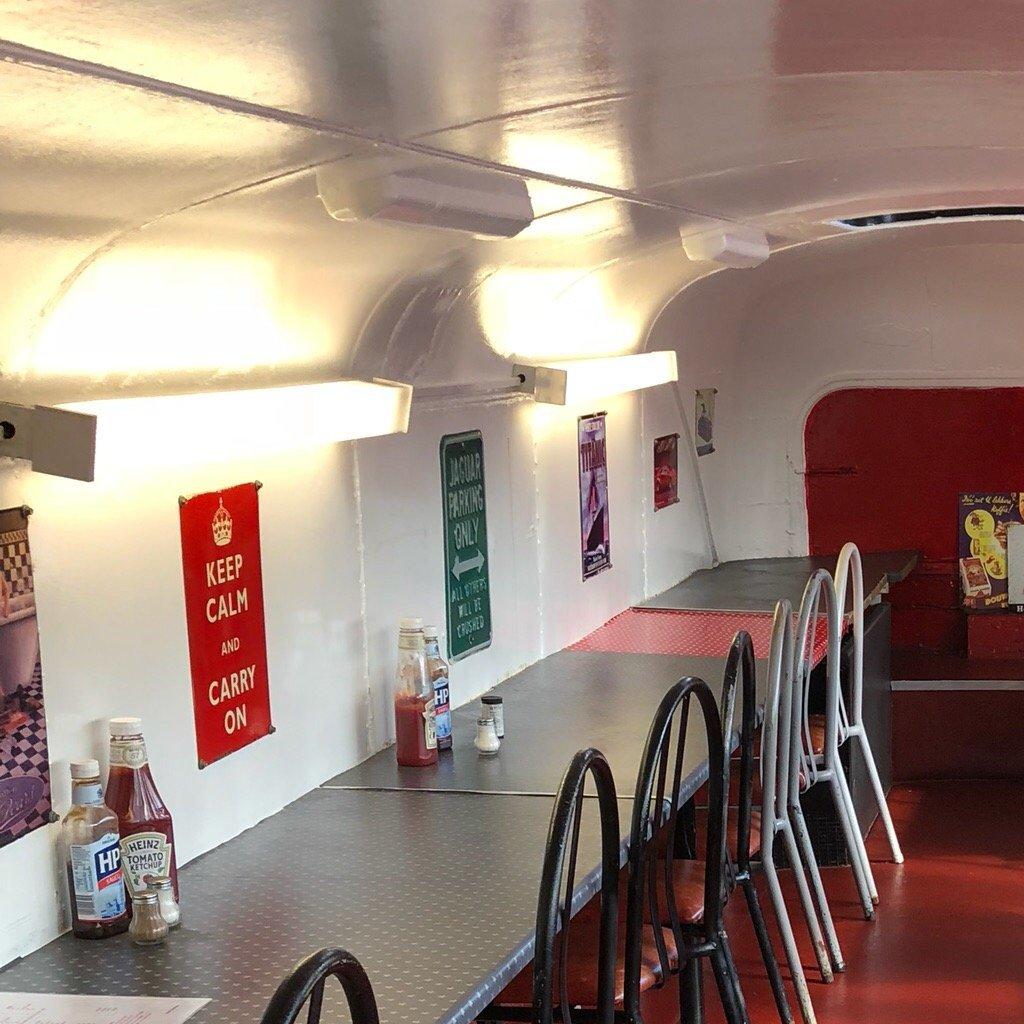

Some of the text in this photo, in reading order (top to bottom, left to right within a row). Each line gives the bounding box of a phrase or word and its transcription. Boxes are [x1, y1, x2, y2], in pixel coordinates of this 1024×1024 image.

[449, 452, 481, 487] JAGUAR
[449, 484, 483, 519] PARKING
[454, 517, 479, 550] ONLY
[205, 553, 243, 587] KEEP
[205, 587, 248, 623] CALM
[221, 637, 240, 656] AND
[208, 664, 256, 706] CARRY
[434, 688, 448, 706] HP
[224, 703, 247, 735] ON
[98, 847, 120, 873] HP
[127, 852, 164, 865] TOMATO
[128, 840, 160, 852] HEINZ
[130, 861, 162, 871] KETCHUP
